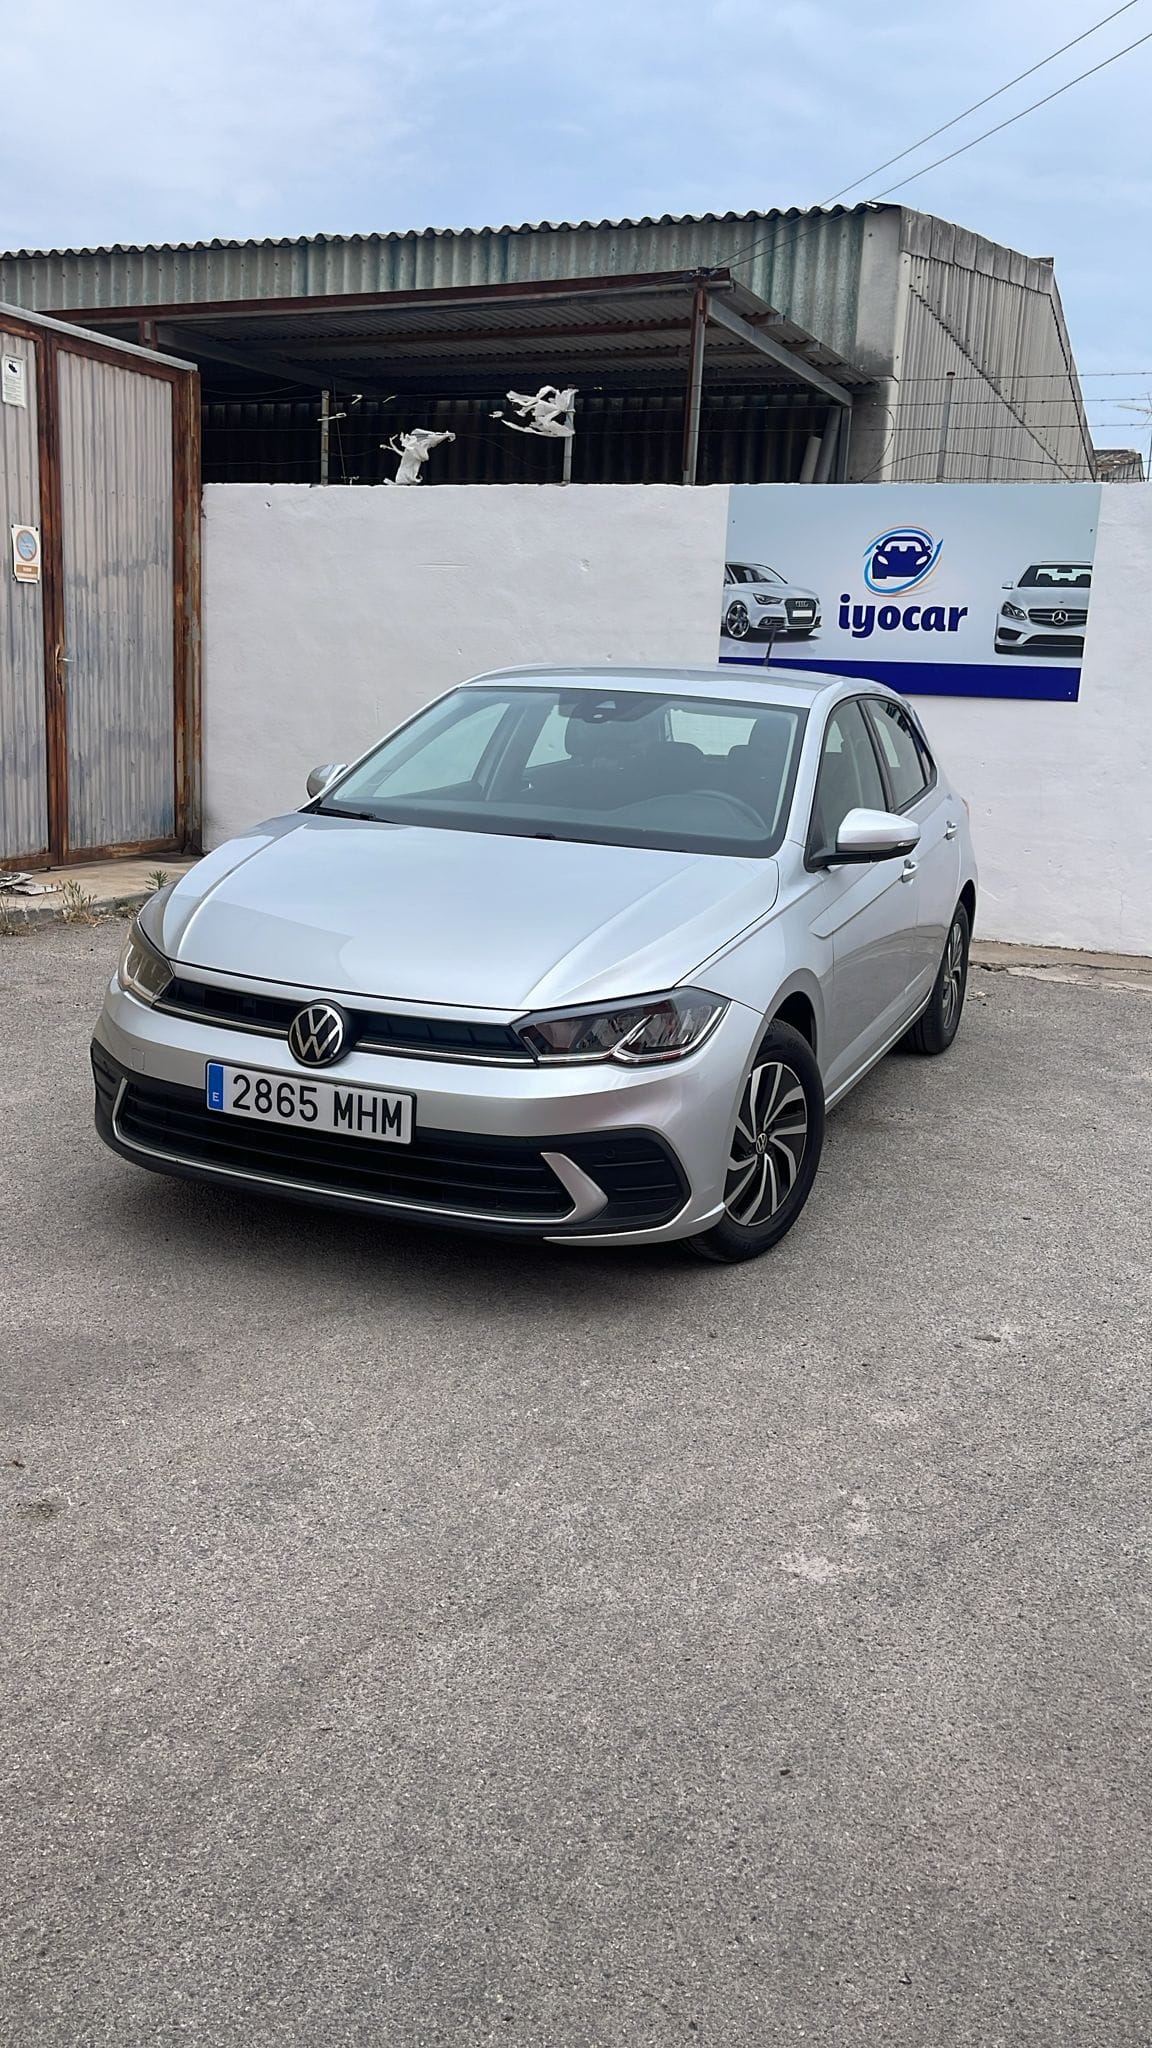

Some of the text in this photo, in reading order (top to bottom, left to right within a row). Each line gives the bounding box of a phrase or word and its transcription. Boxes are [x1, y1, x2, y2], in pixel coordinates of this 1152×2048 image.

[838, 593, 969, 639] iyocar
[212, 1092, 220, 1102] E
[232, 1074, 402, 1137] 2865 MHM
